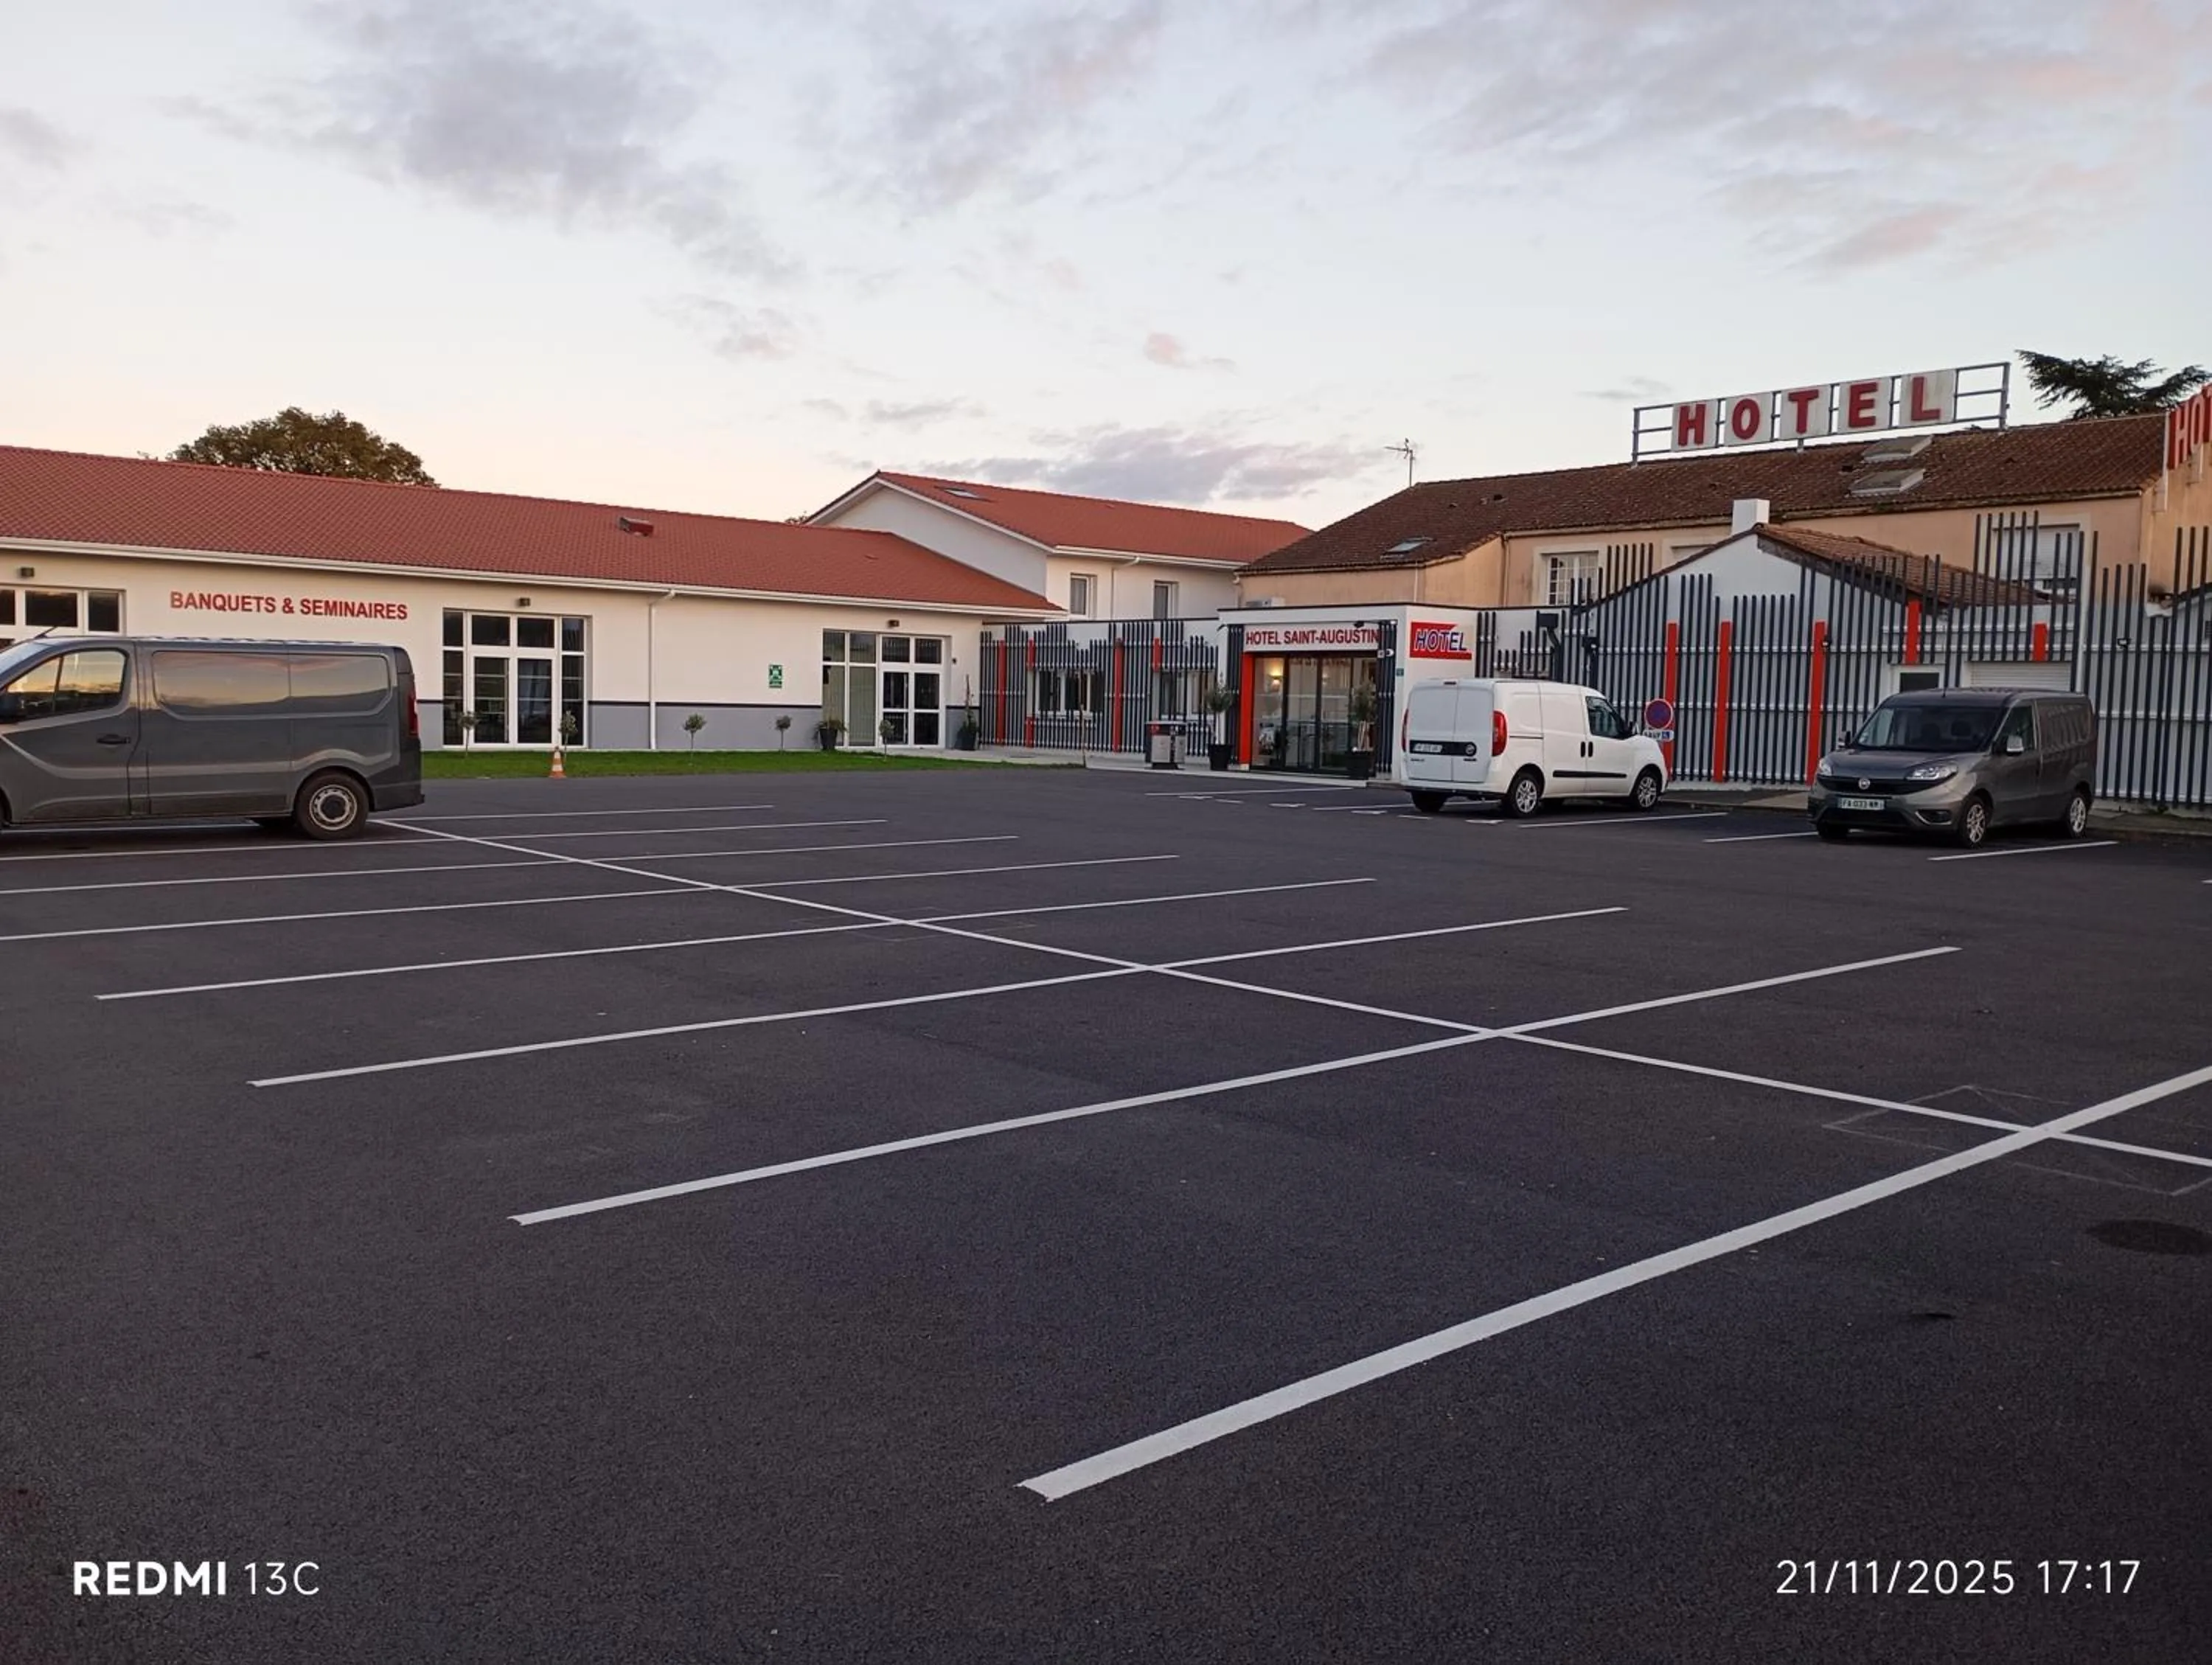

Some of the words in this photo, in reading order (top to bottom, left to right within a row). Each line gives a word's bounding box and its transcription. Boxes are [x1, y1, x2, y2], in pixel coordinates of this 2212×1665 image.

[1677, 377, 1941, 445] HOTEL
[170, 591, 276, 613] BANQUETS
[282, 598, 294, 613] &
[300, 599, 408, 619] SEMINAIRES
[1246, 630, 1281, 644] HOTEL
[1284, 629, 1380, 644] SAINT-AUGUSTIN
[1414, 629, 1467, 652] HOTEL
